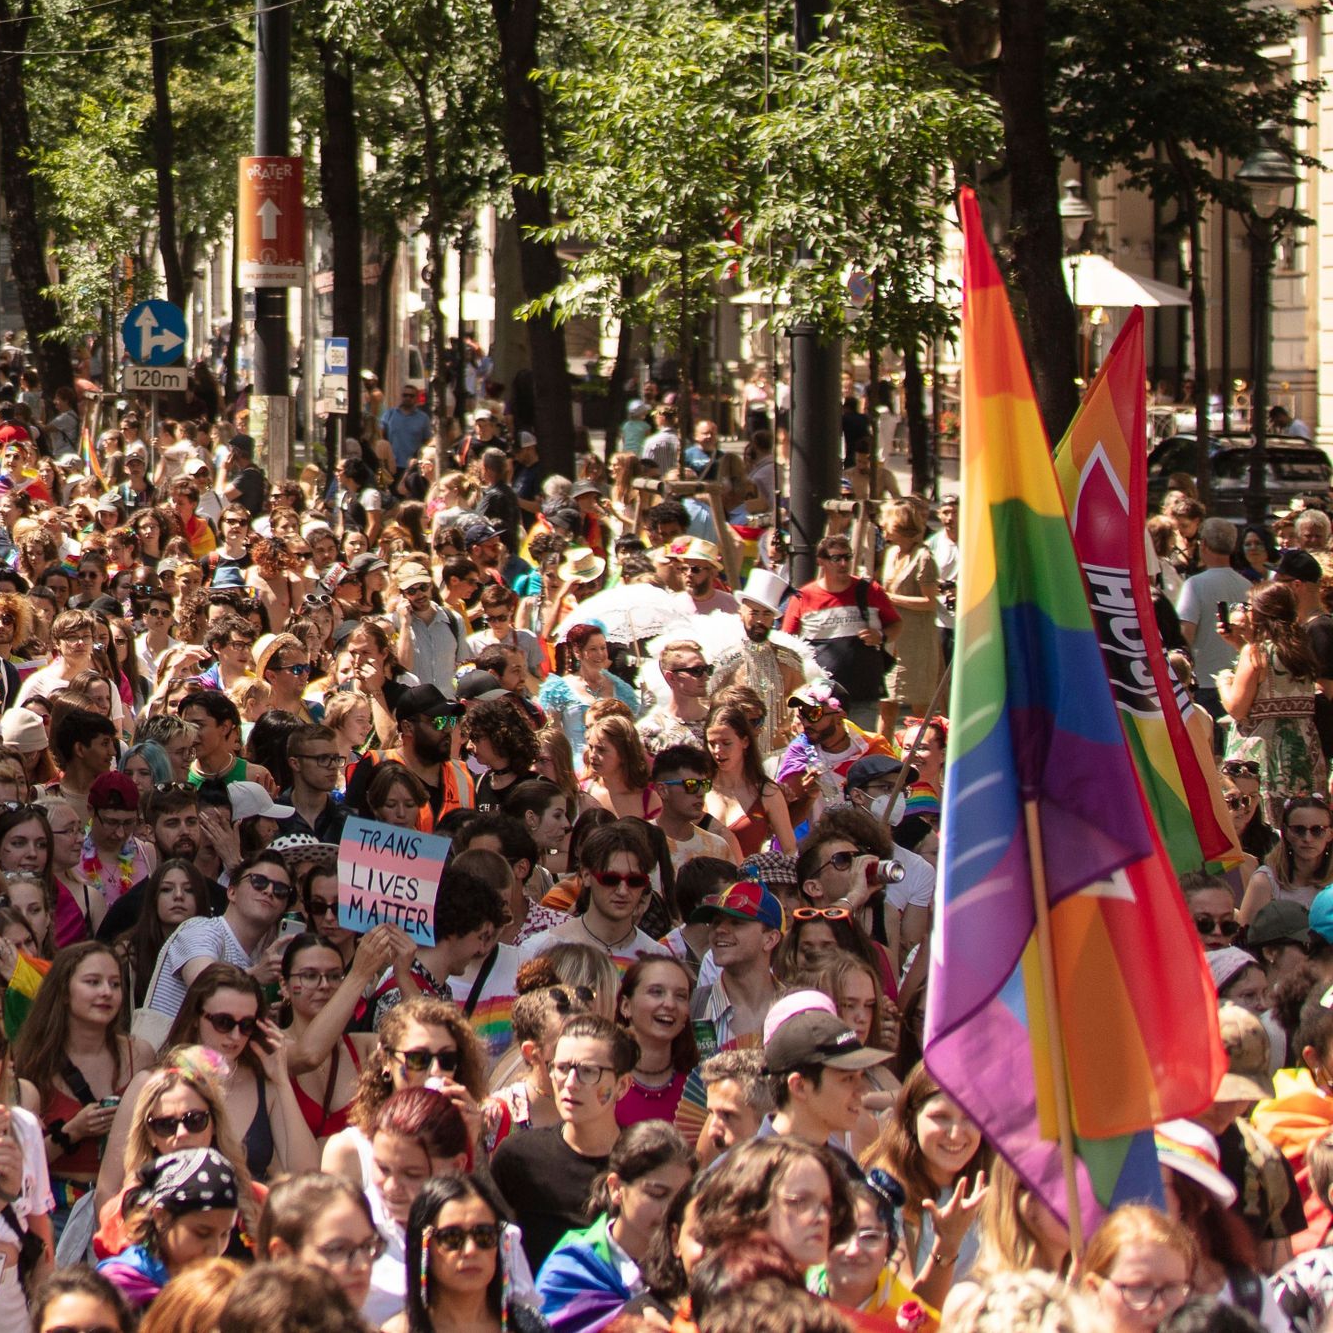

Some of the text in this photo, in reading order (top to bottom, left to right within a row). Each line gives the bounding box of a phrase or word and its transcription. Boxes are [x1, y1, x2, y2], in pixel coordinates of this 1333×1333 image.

[246, 163, 293, 180] PRATER
[133, 369, 180, 387] 120m
[359, 828, 422, 860] TRANS
[351, 861, 420, 901] LIVES
[348, 894, 432, 938] MATTER
